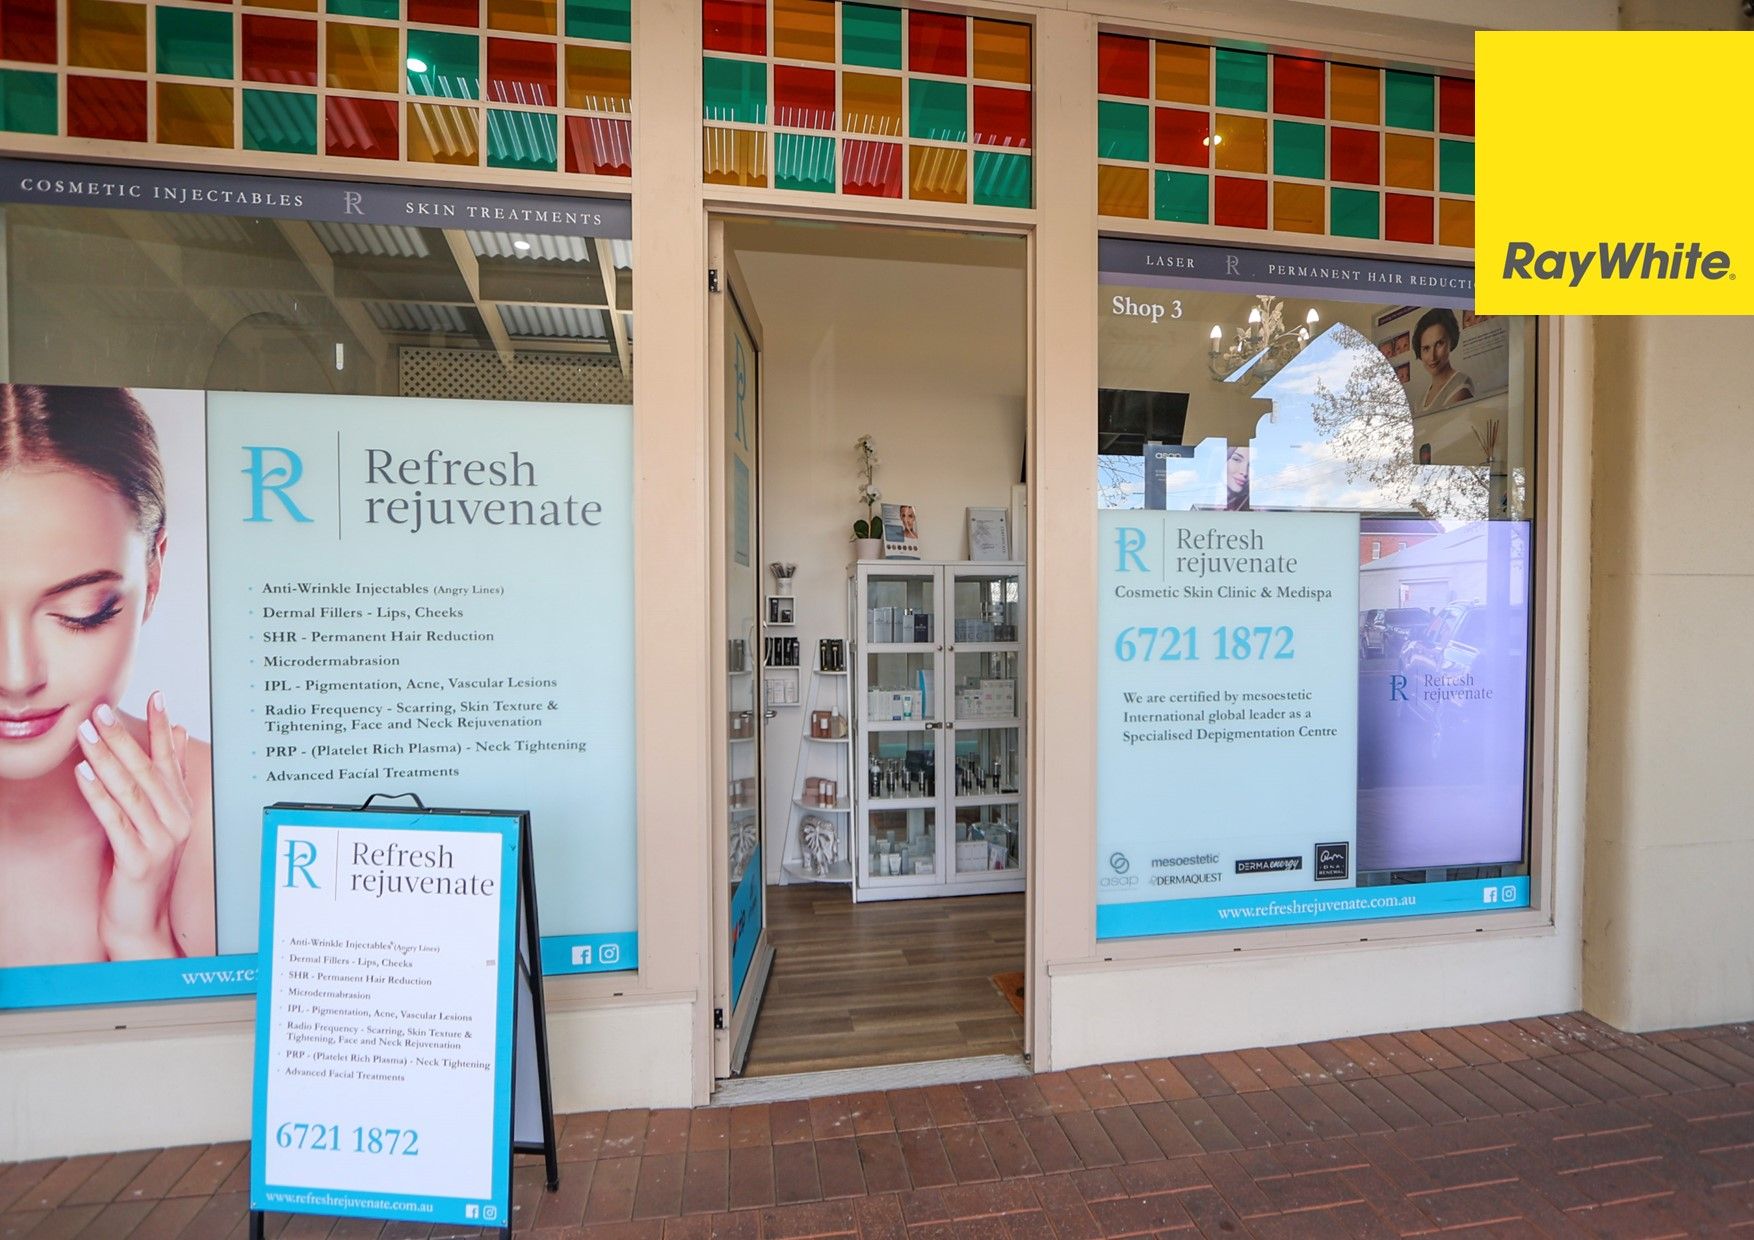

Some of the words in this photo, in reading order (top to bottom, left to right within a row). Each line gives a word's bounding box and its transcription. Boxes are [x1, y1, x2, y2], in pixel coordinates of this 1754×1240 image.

[20, 178, 142, 198] COSMETIC
[153, 186, 304, 207] INJECTABLES
[405, 201, 456, 217] SKIN
[467, 206, 602, 226] TREATMENTS
[1147, 255, 1195, 268] LASER
[1269, 264, 1361, 280] PERMANENT
[1368, 272, 1403, 284] HAIR
[1410, 275, 1475, 289] REDUCTI
[1112, 296, 1164, 324] Shop
[1171, 300, 1182, 318] 3
[365, 448, 538, 487] Refresh
[364, 490, 603, 534] rejuvenate
[1176, 527, 1265, 551] Refresh
[1176, 553, 1298, 578] rejuvenate
[261, 582, 351, 594] Anti-Wrinkle
[356, 583, 429, 596] Injectables
[433, 585, 469, 596] (Angry
[472, 585, 504, 596] Lines)
[1115, 585, 1180, 598] Cosmetic
[1184, 585, 1213, 598] Skin
[1217, 586, 1257, 598] Clinic
[1261, 586, 1272, 598] &
[1276, 586, 1332, 601] Medispa
[263, 607, 315, 618] Dermal
[320, 607, 363, 618] Fillers
[377, 607, 410, 621] Lips,
[415, 606, 463, 618] Cheeks
[263, 631, 297, 642] SHR
[311, 631, 386, 642] Permanent
[391, 631, 421, 642] Hair
[426, 630, 494, 641] Reduction
[1115, 626, 1199, 662] 6721
[1213, 626, 1295, 660] 1872
[264, 654, 400, 667] Microdermabrasion
[264, 680, 292, 691] IPL
[305, 679, 402, 694] Pigmentation,
[406, 679, 444, 691] Acne,
[449, 677, 504, 689] Vascular
[508, 677, 558, 688] Lesions
[1424, 673, 1474, 687] Refresh
[1123, 691, 1143, 704] We
[1146, 694, 1166, 703] are
[1169, 690, 1220, 703] certified
[1224, 690, 1239, 705] by
[1242, 689, 1312, 701] mesoestetic
[1423, 688, 1493, 703] rejuvenate
[265, 704, 306, 716] Radio
[311, 703, 383, 717] Frequency
[396, 702, 456, 715] Scarring,
[460, 701, 489, 712] Skin
[493, 701, 543, 712] Texture
[547, 700, 559, 711] &
[1123, 710, 1205, 723] International
[1208, 709, 1245, 724] global
[1249, 708, 1285, 721] leader
[1289, 711, 1301, 720] as
[1305, 710, 1312, 719] a
[265, 719, 347, 735] Tightening,
[351, 719, 383, 730] Face
[387, 718, 412, 729] and
[416, 718, 453, 728] Neck
[457, 716, 542, 730] Rejuvenation
[1123, 729, 1193, 745] Specialised
[1197, 726, 1295, 744] Depigmentation
[1299, 725, 1338, 738] Centre
[266, 746, 297, 757] PRP
[311, 744, 367, 759] (Platelet
[372, 743, 404, 755] Rich
[408, 742, 462, 755] Plasma)
[475, 741, 511, 752] Neck
[514, 739, 587, 753] Tightening
[266, 770, 334, 782] Advanced
[339, 768, 379, 780] Facial
[383, 767, 459, 778] Treatments
[352, 840, 454, 869] Refresh
[1151, 853, 1219, 868] mesoestetic
[350, 869, 495, 898] rejuvenate
[1100, 874, 1139, 888] asap
[1218, 893, 1416, 920] www.refreshrejuvenate.com.au
[289, 937, 343, 948] Anti-Wrinkle
[289, 954, 321, 963] Dermal
[323, 955, 350, 965] Fillers
[358, 957, 379, 968] Lips,
[381, 958, 413, 968] Cheeks
[182, 968, 259, 985] www.re
[288, 971, 309, 980] SHR
[317, 972, 363, 983] Permanent
[365, 974, 386, 983] Hair
[388, 975, 432, 986] Reduction
[288, 987, 371, 1000] Microdermabrasion
[287, 1004, 304, 1013] IPL
[312, 1005, 371, 1018] Pigmentation,
[373, 1009, 398, 1019] Acne,
[400, 1010, 436, 1020] Vascular
[439, 1011, 472, 1021] Lesions
[287, 1021, 312, 1030] Radio
[314, 1022, 358, 1034] Frequency
[366, 1025, 405, 1036] Scarring,
[407, 1027, 426, 1036] Skin
[429, 1028, 462, 1038] Texture
[464, 1030, 472, 1038] &
[287, 1032, 335, 1044] Tightening,
[338, 1035, 358, 1044] Face
[360, 1037, 376, 1045] and
[378, 1037, 402, 1046] Neck
[404, 1039, 461, 1049] Rejuvenation
[286, 1050, 305, 1058] PRP
[313, 1051, 348, 1062] (Platelet
[350, 1053, 370, 1062] Rich
[372, 1055, 407, 1065] Plasma)
[416, 1057, 439, 1066] Neck
[441, 1058, 491, 1070] Tightening
[285, 1067, 326, 1077] Advanced
[328, 1069, 354, 1079] Facial
[356, 1071, 405, 1081] Treatments
[275, 1122, 341, 1152] 6721
[352, 1126, 419, 1157] 1872
[265, 1191, 434, 1214] www.refreshrejuvenate.com.au
